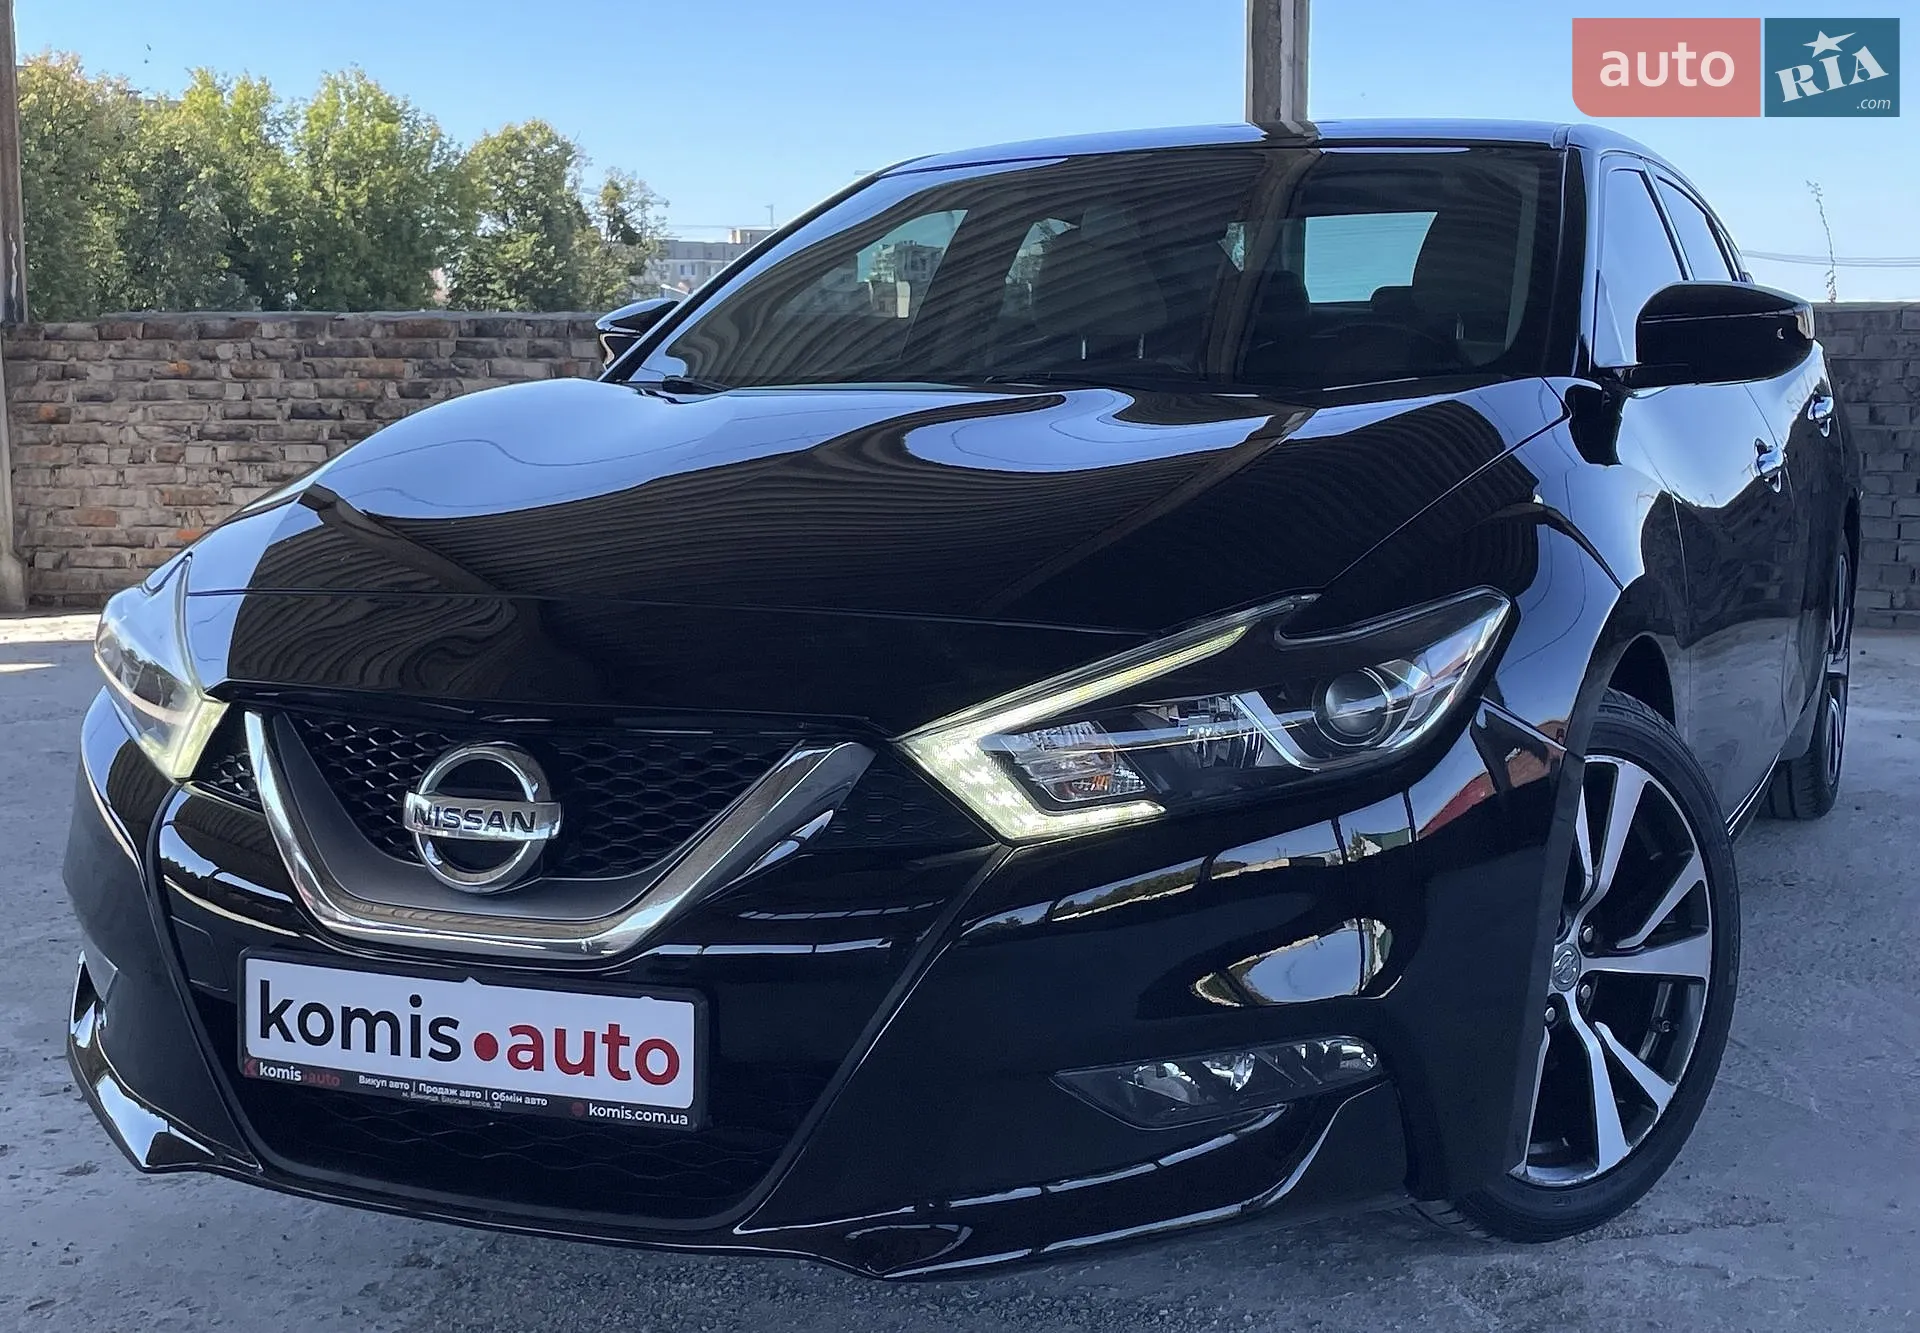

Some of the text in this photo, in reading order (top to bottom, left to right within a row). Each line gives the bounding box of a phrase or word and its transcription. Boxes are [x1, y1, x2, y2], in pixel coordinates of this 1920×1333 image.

[413, 803, 537, 833] NISSAN
[358, 1074, 548, 1107] Викуп авто Продаж авто Обмін авто
[588, 1102, 689, 1126] komis.com.ua
